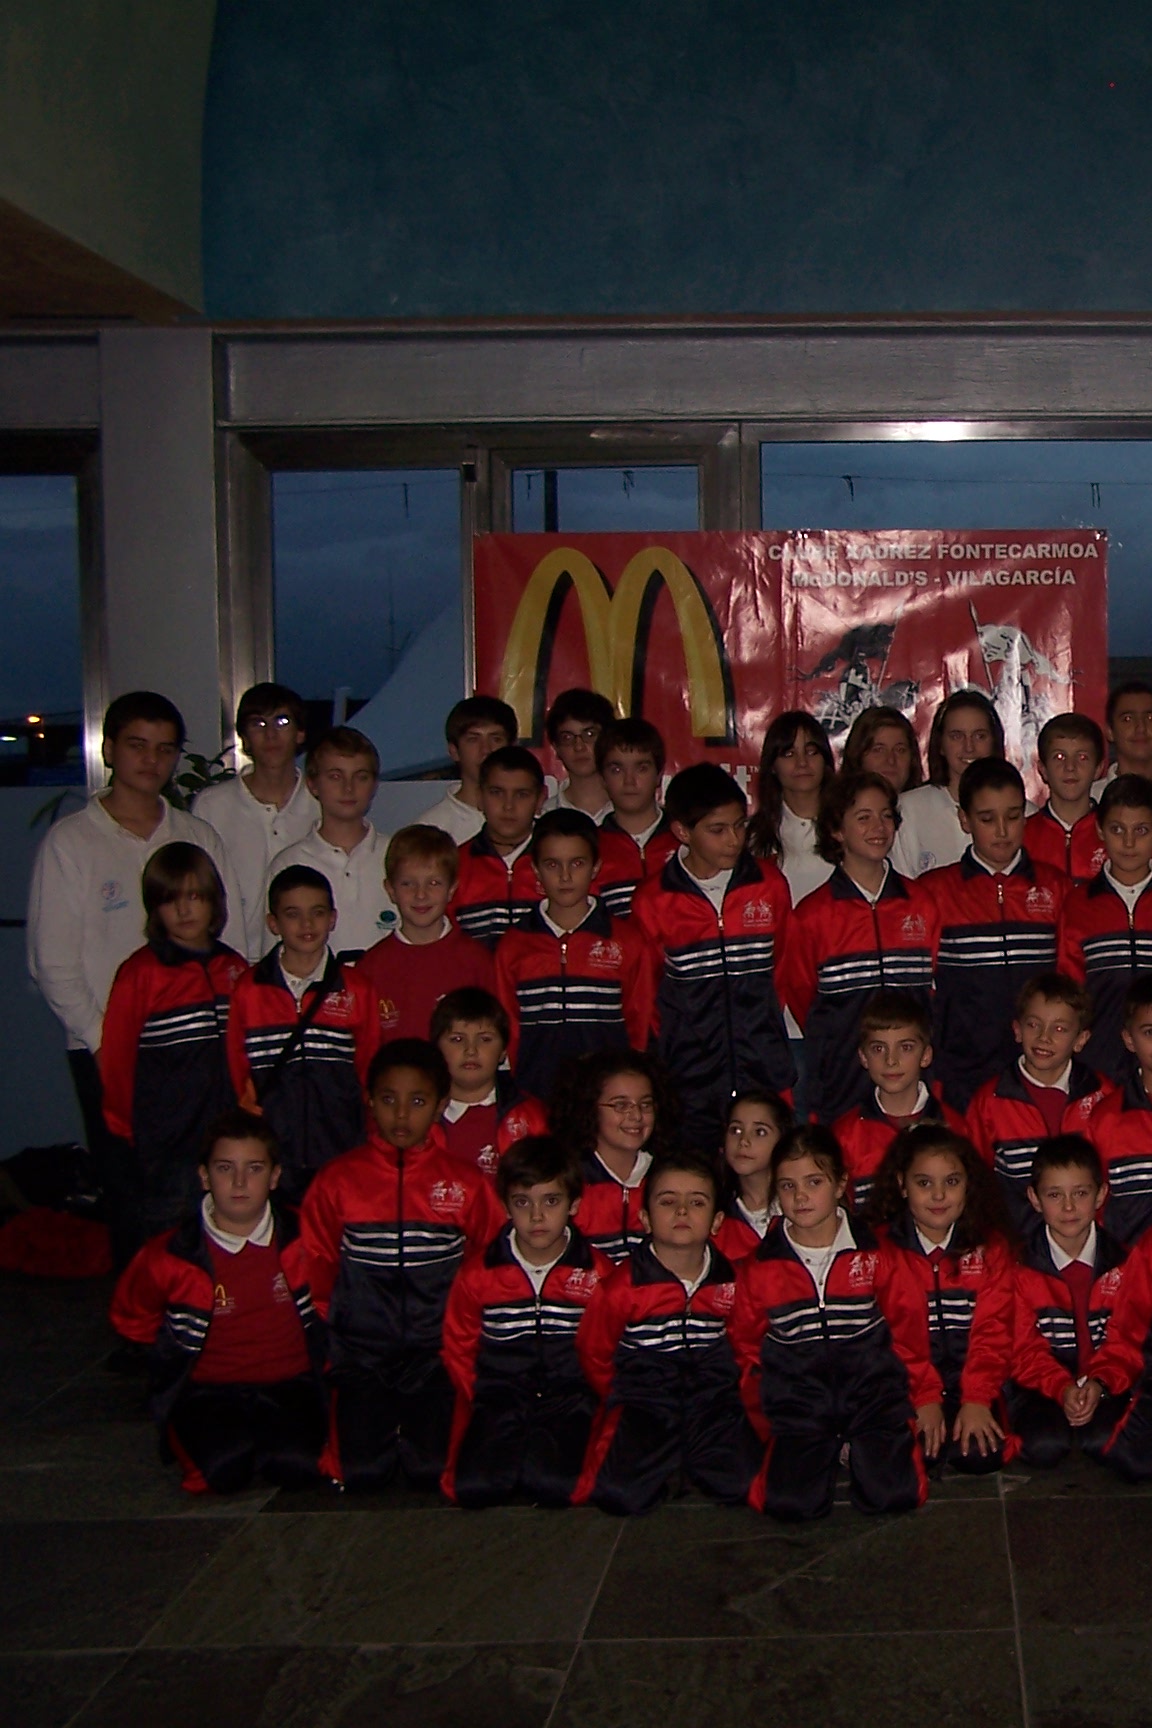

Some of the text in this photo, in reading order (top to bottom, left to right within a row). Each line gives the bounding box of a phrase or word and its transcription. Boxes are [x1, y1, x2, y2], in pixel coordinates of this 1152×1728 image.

[768, 543, 1099, 560] CUBE XADREZ FONTECARMOA
[792, 571, 929, 587] McDONALD'S
[947, 566, 1076, 586] VILAGARCÍA
